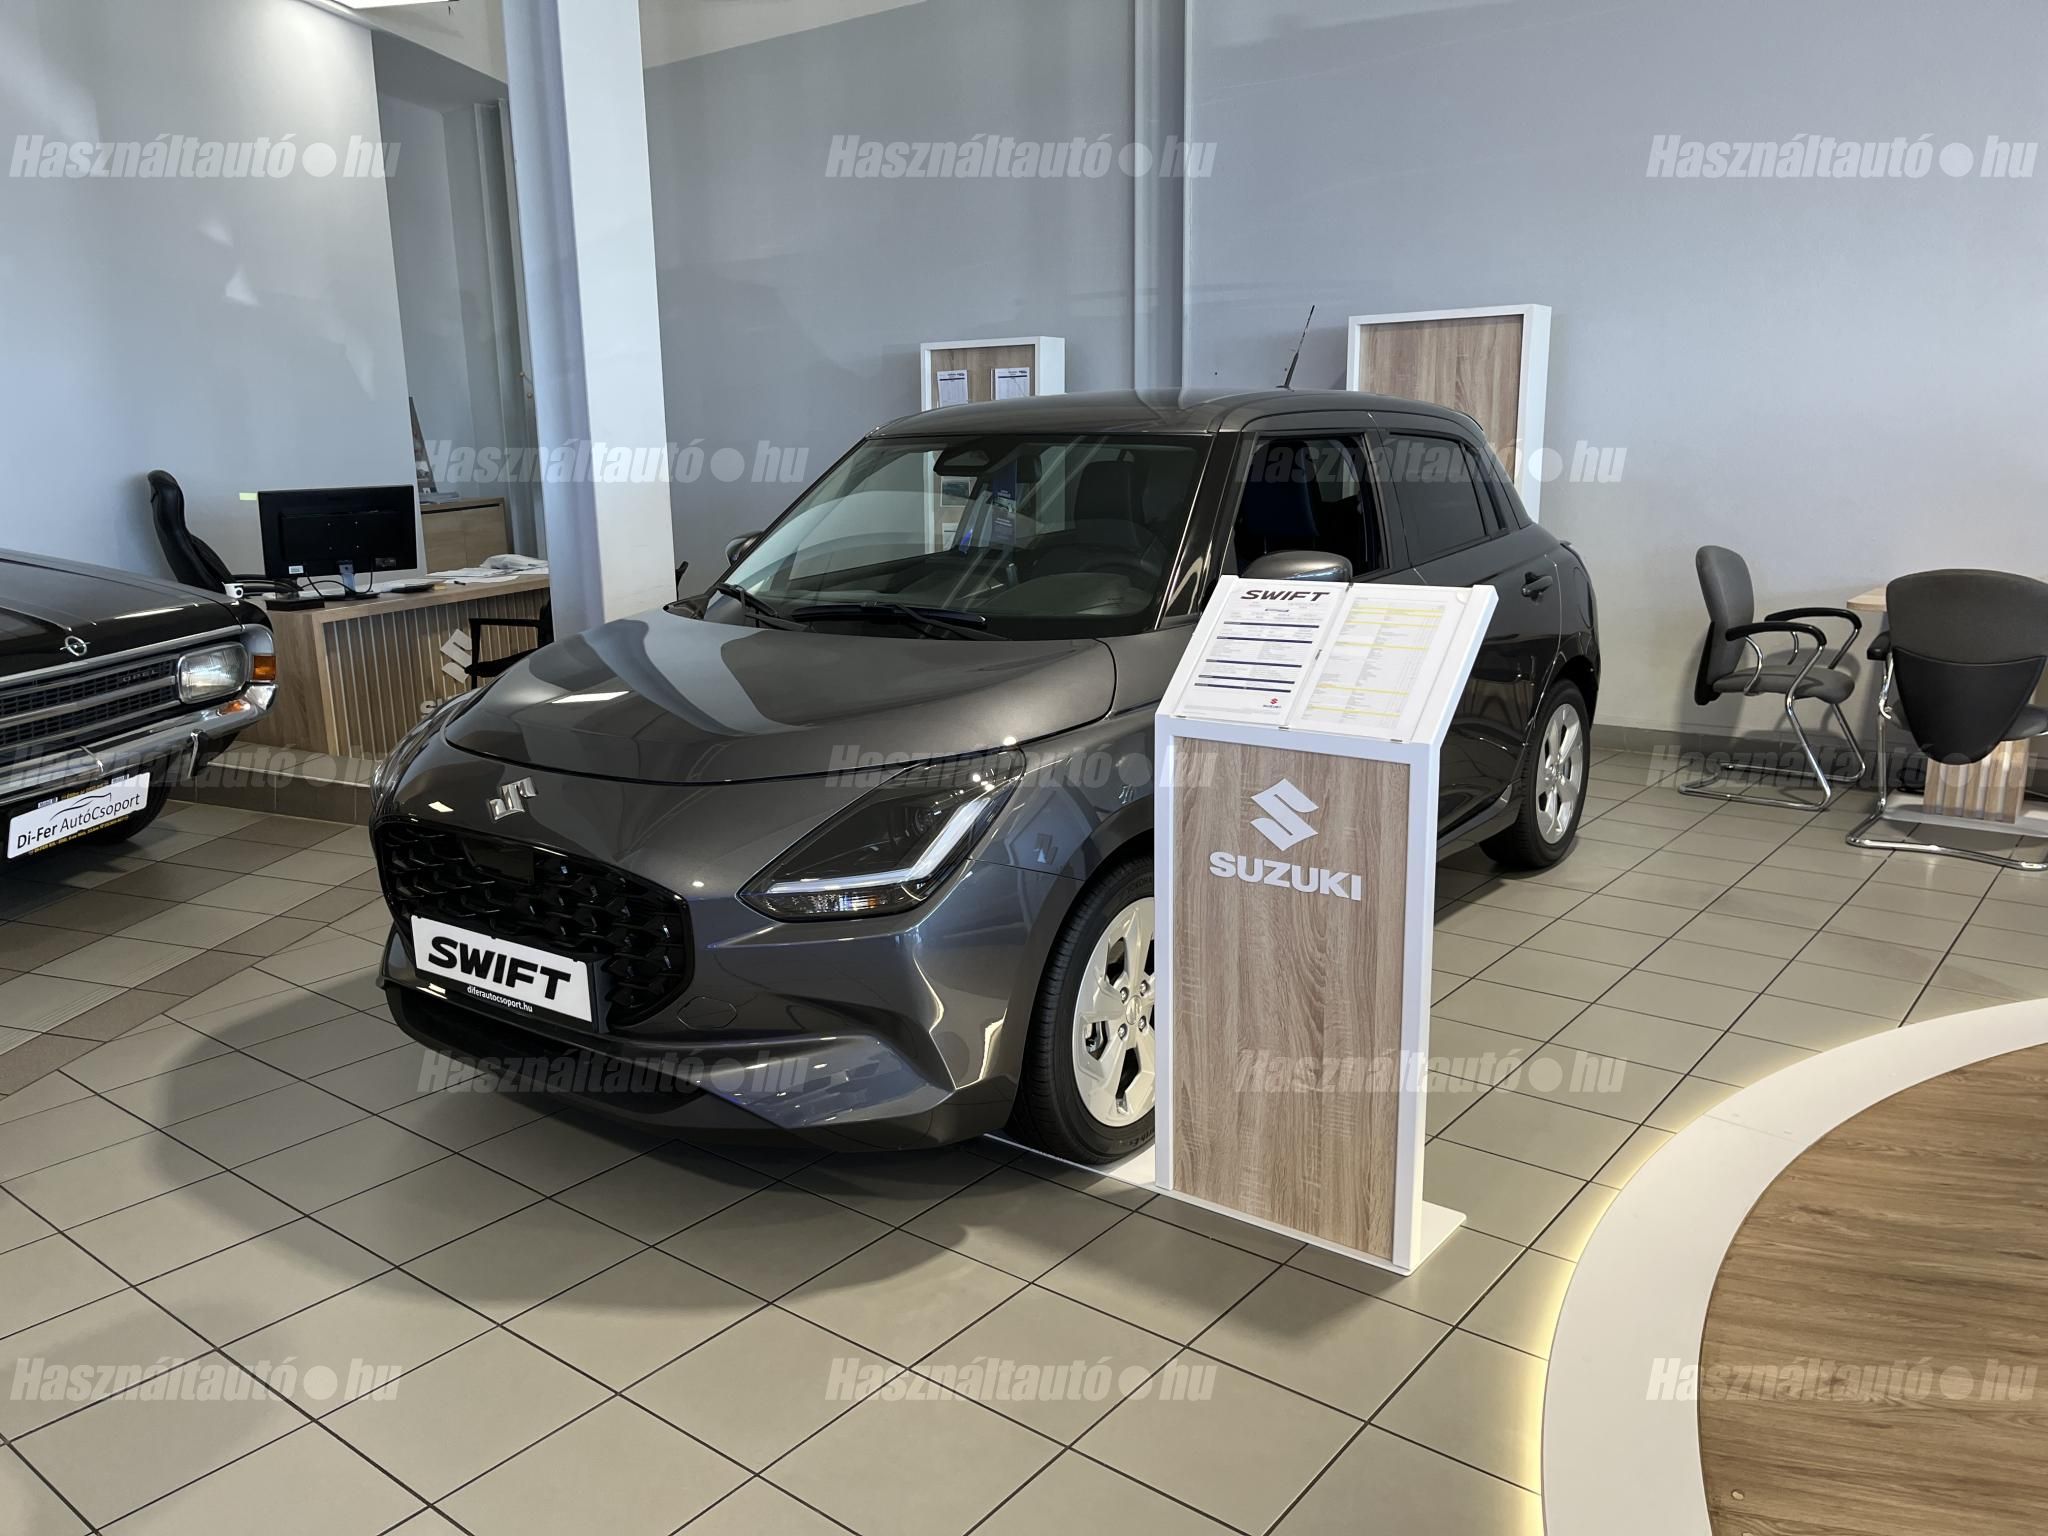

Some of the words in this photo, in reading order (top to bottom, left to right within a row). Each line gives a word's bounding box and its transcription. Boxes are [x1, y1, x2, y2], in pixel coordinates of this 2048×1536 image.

[1240, 589, 1330, 602] SWIFT
[17, 822, 58, 849] Di-Fer
[59, 793, 141, 832] AutóCsoport
[1209, 851, 1362, 901] SUZUKI
[428, 936, 571, 1000] SWIFT
[467, 985, 533, 1013] diferautocsoport.hu
